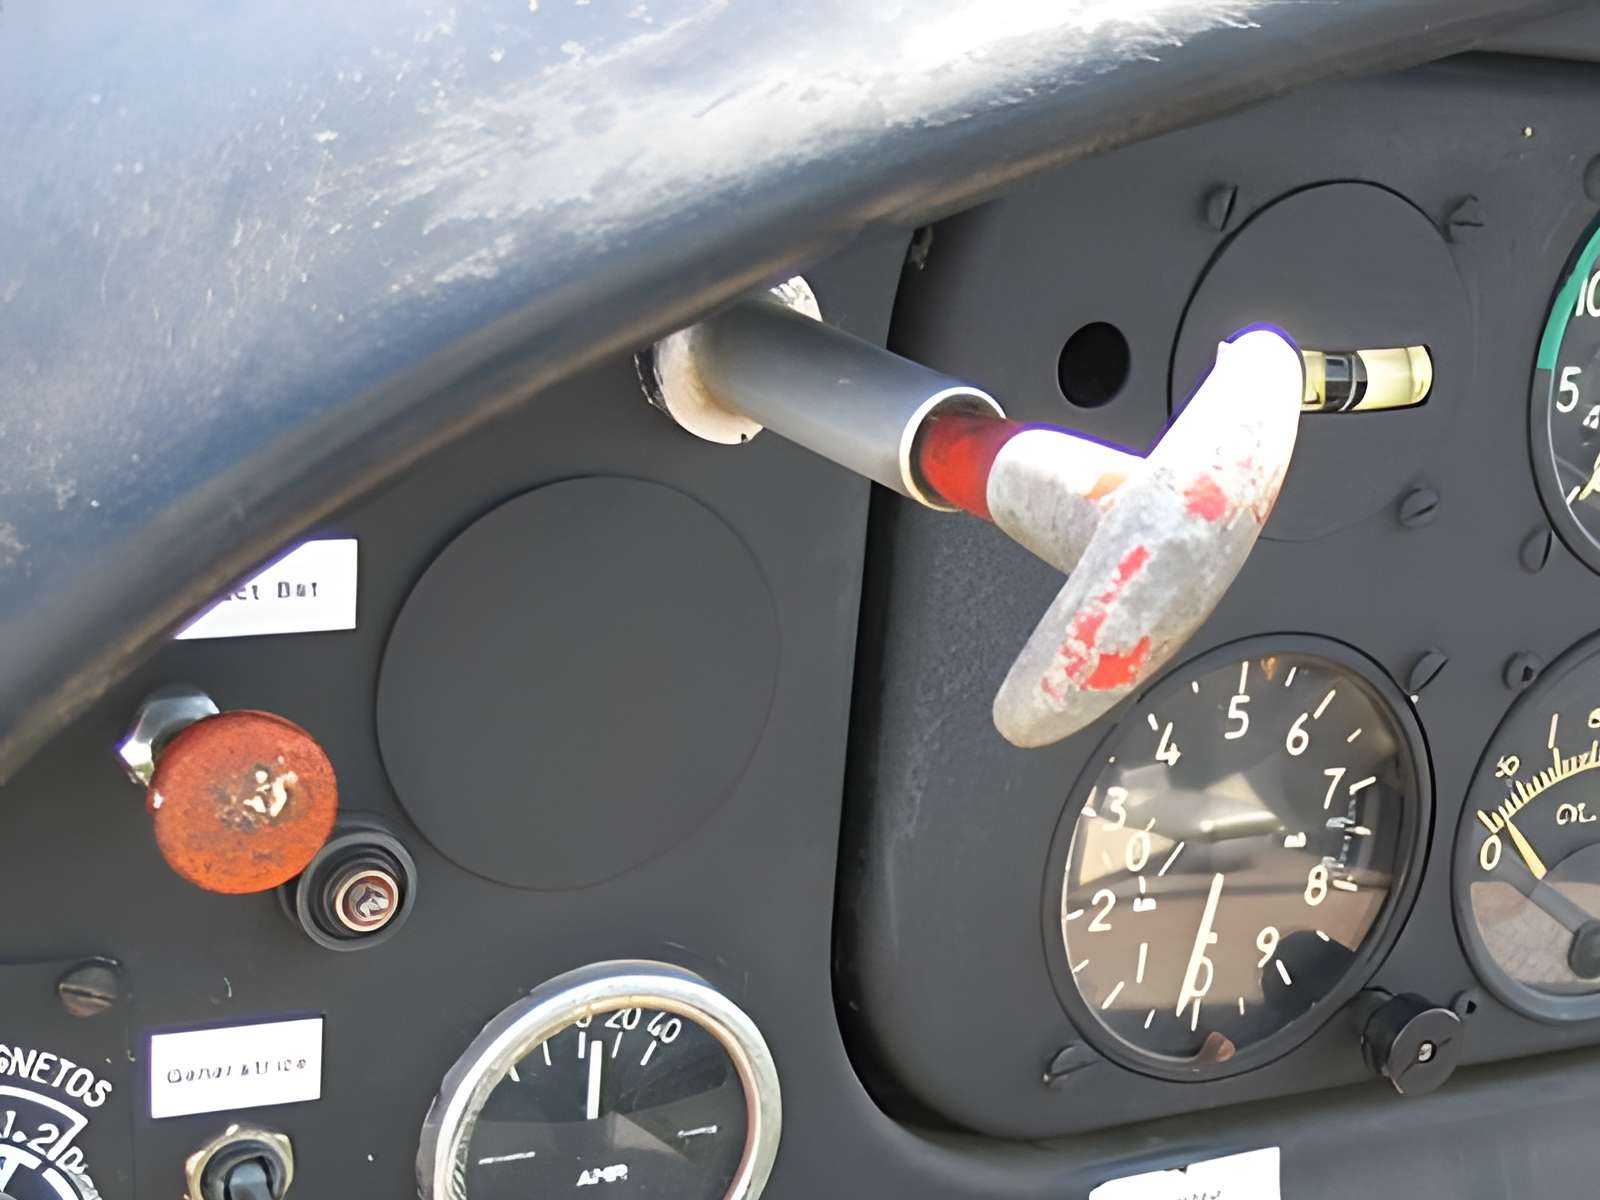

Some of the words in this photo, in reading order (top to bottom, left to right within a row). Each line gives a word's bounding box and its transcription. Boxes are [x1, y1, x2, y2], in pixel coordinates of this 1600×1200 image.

[1556, 366, 1582, 413] 5
[1224, 695, 1250, 739] 5
[1286, 713, 1310, 756] 6
[1156, 722, 1182, 765] 4
[1102, 787, 1128, 831] 3
[1323, 768, 1347, 809] 7
[1480, 834, 1502, 871] 0
[1304, 865, 1328, 906] 8
[1087, 889, 1116, 932] 2
[1256, 926, 1280, 968] 9
